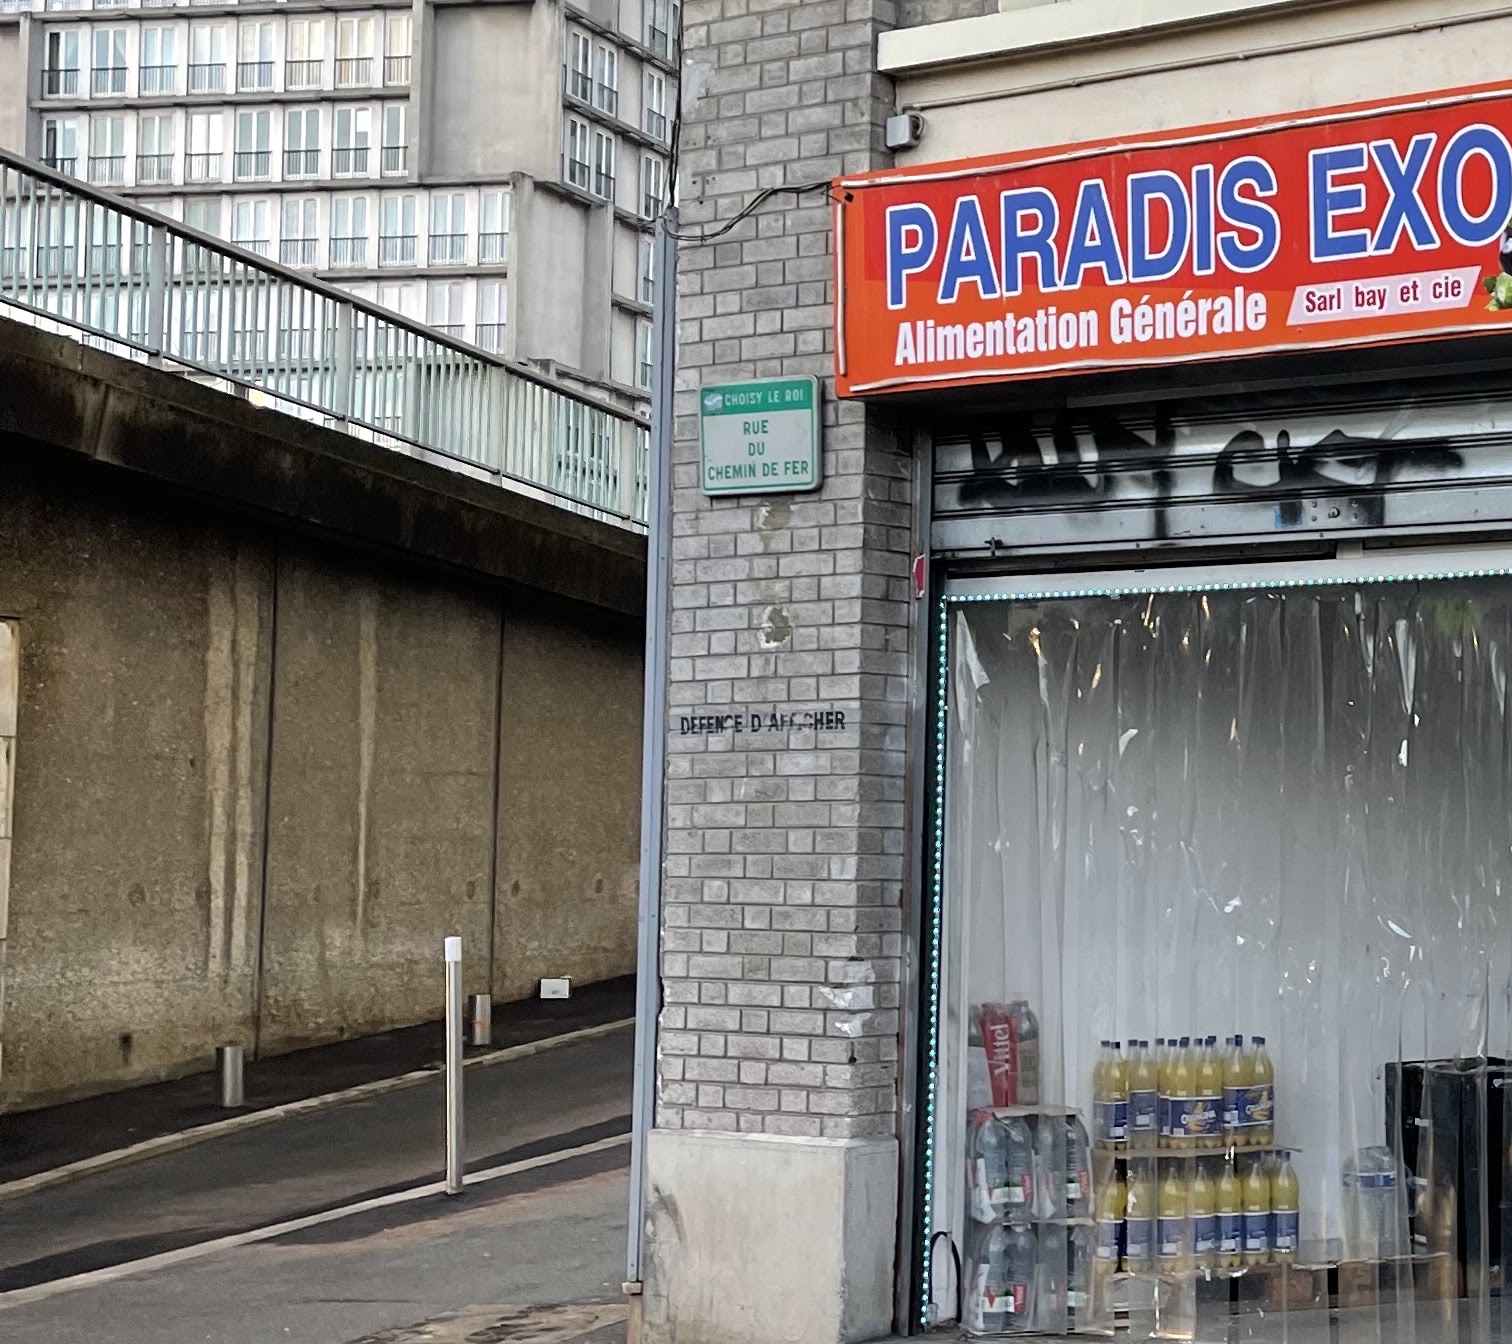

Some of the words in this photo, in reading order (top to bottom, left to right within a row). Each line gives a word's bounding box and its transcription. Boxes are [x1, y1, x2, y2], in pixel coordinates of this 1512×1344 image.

[885, 156, 1281, 309] PARADIS
[1304, 285, 1342, 313] Sarl
[1354, 283, 1387, 310] bay
[1399, 279, 1419, 303] et
[1431, 273, 1462, 299] cie
[894, 306, 1099, 366] Alimentation
[1109, 286, 1267, 344] Générale
[724, 391, 763, 406] CHOISY
[767, 390, 780, 404] LE
[785, 388, 804, 402] ROI
[743, 419, 769, 435] RUE
[748, 442, 765, 456] DU
[708, 463, 756, 480] CHEMIN
[762, 462, 778, 477] DE
[784, 460, 809, 475] FER
